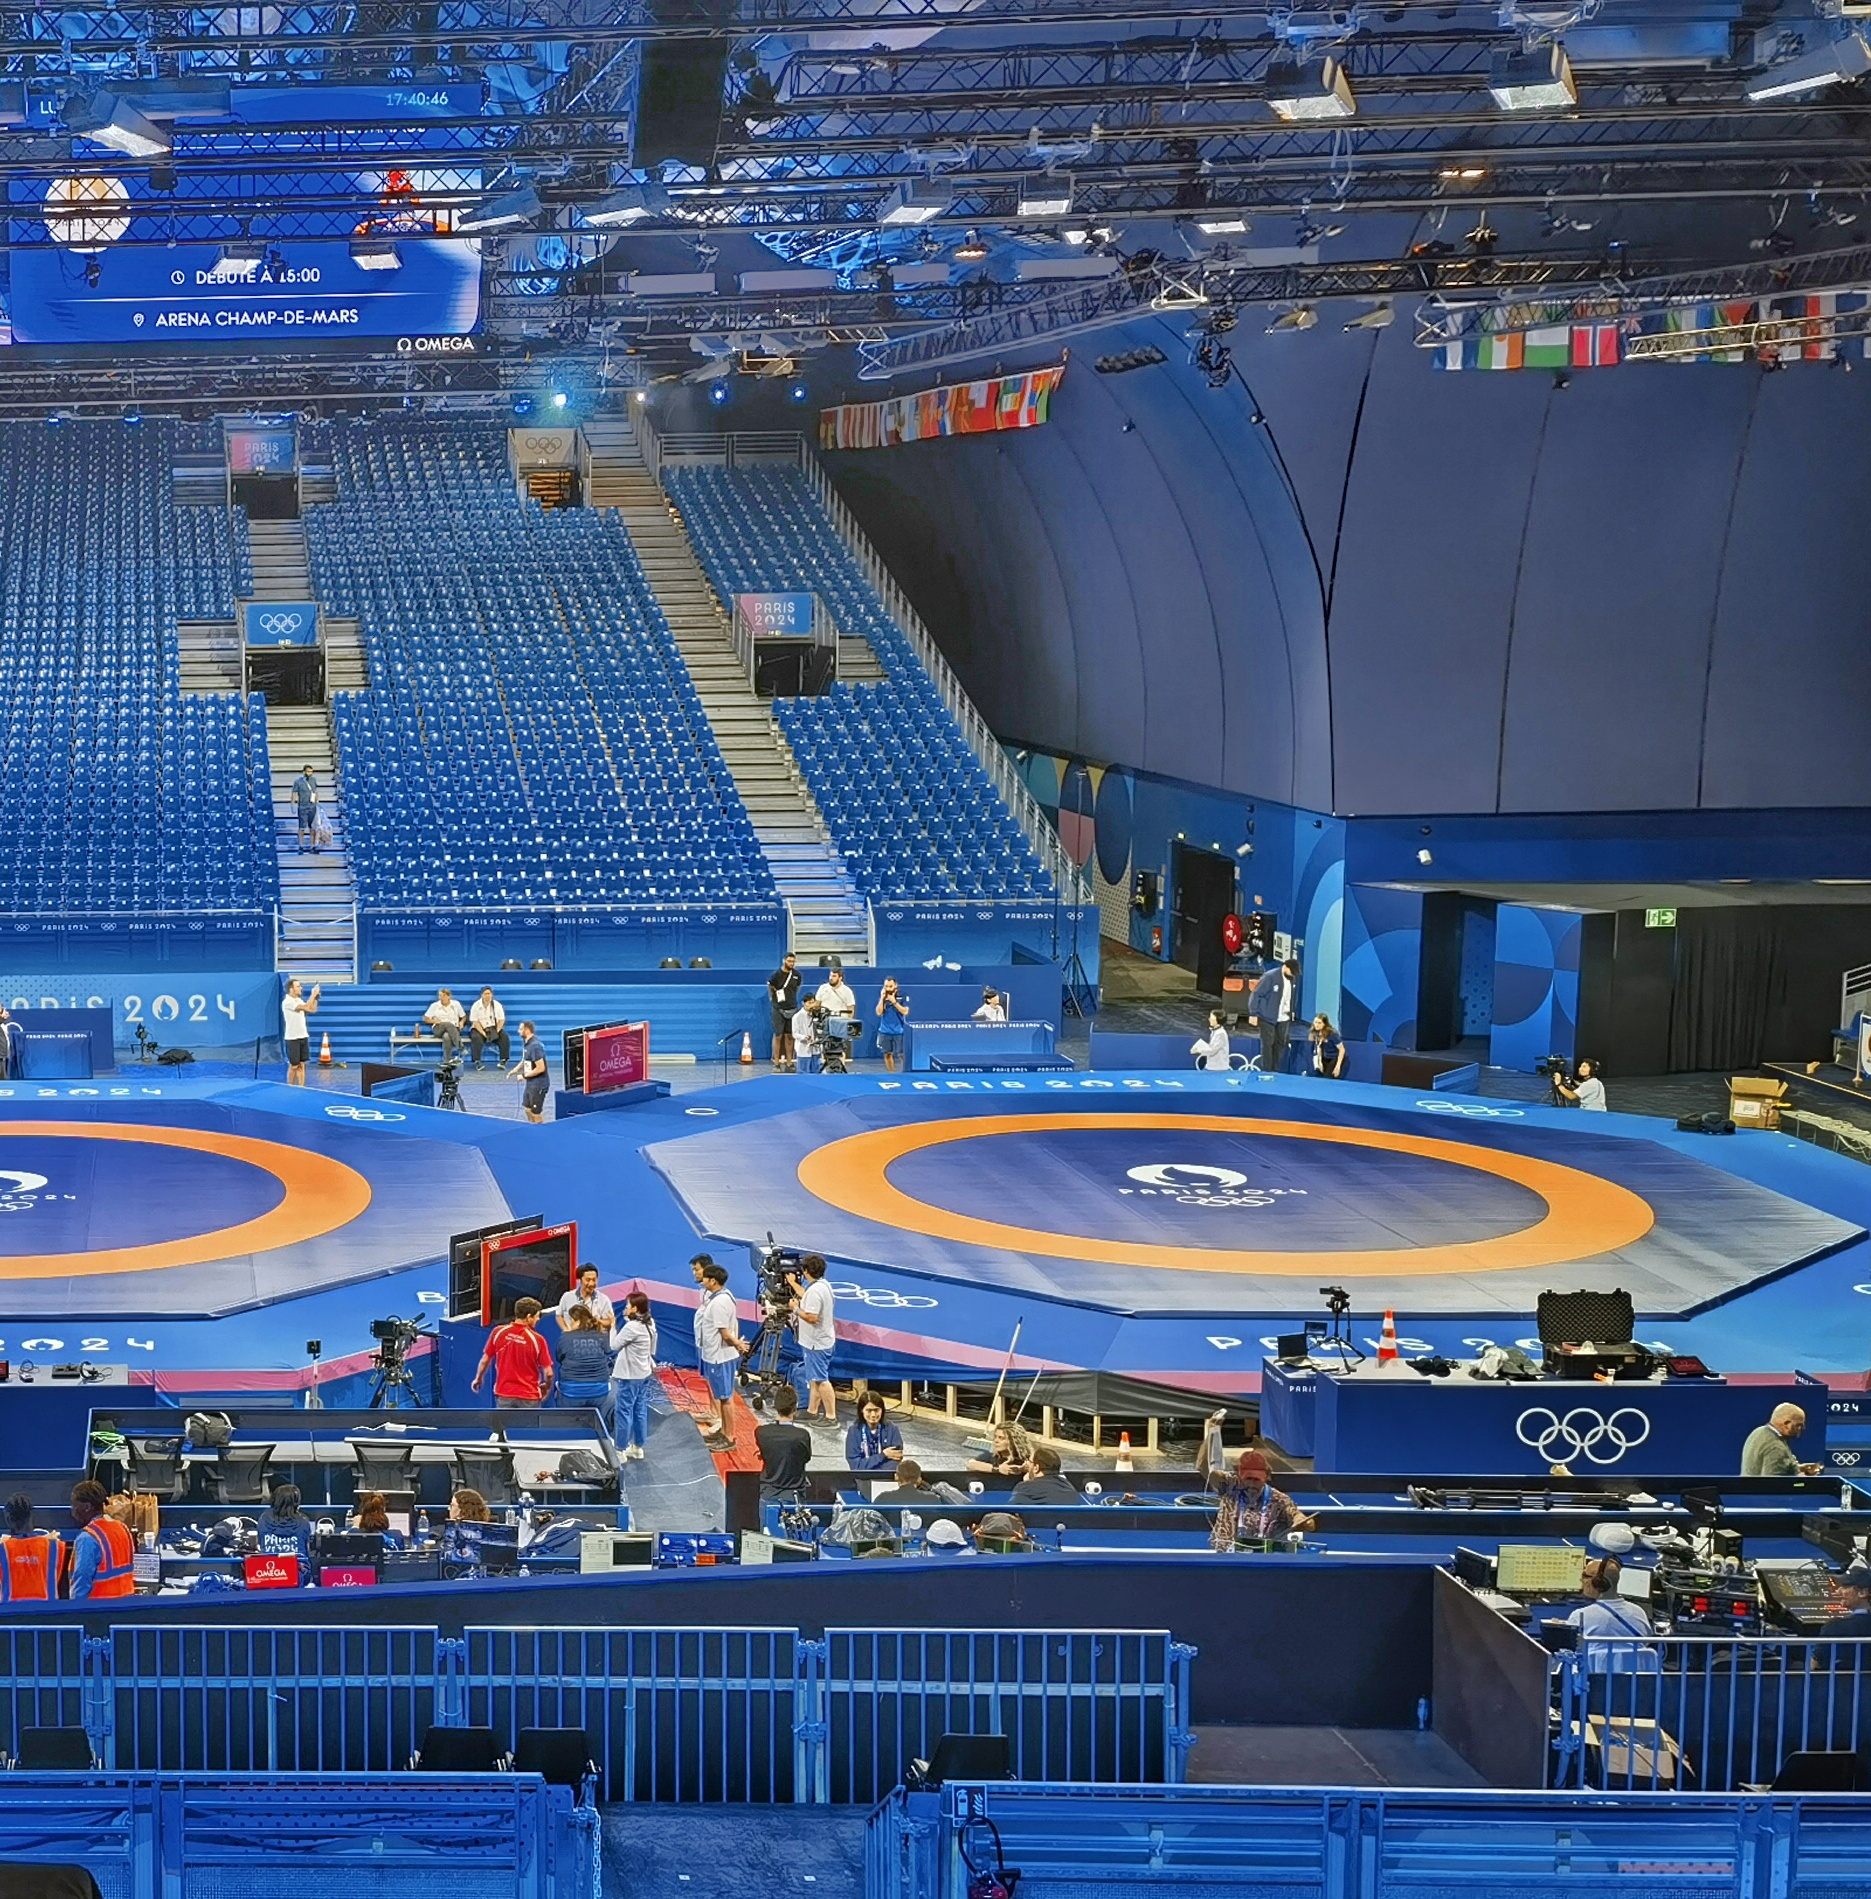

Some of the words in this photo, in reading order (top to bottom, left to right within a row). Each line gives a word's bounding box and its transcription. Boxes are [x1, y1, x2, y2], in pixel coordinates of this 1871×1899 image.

[386, 92, 448, 106] 17:40:46
[156, 312, 212, 327] ARENA
[215, 308, 359, 326] CHAMP-DE-MARS
[414, 336, 474, 350] OMEGA
[245, 442, 279, 452] PARIS
[755, 602, 795, 613] PARIS
[755, 614, 795, 625] 2024
[124, 994, 235, 1021] 2024
[599, 1056, 632, 1072] OMEGA
[878, 1080, 1026, 1090] PARIS
[1045, 1080, 1184, 1090] 2024
[36, 1088, 162, 1098] 2024
[416, 1292, 446, 1303] B
[1827, 1404, 1858, 1412] 024
[256, 1569, 286, 1578] OMEGA
